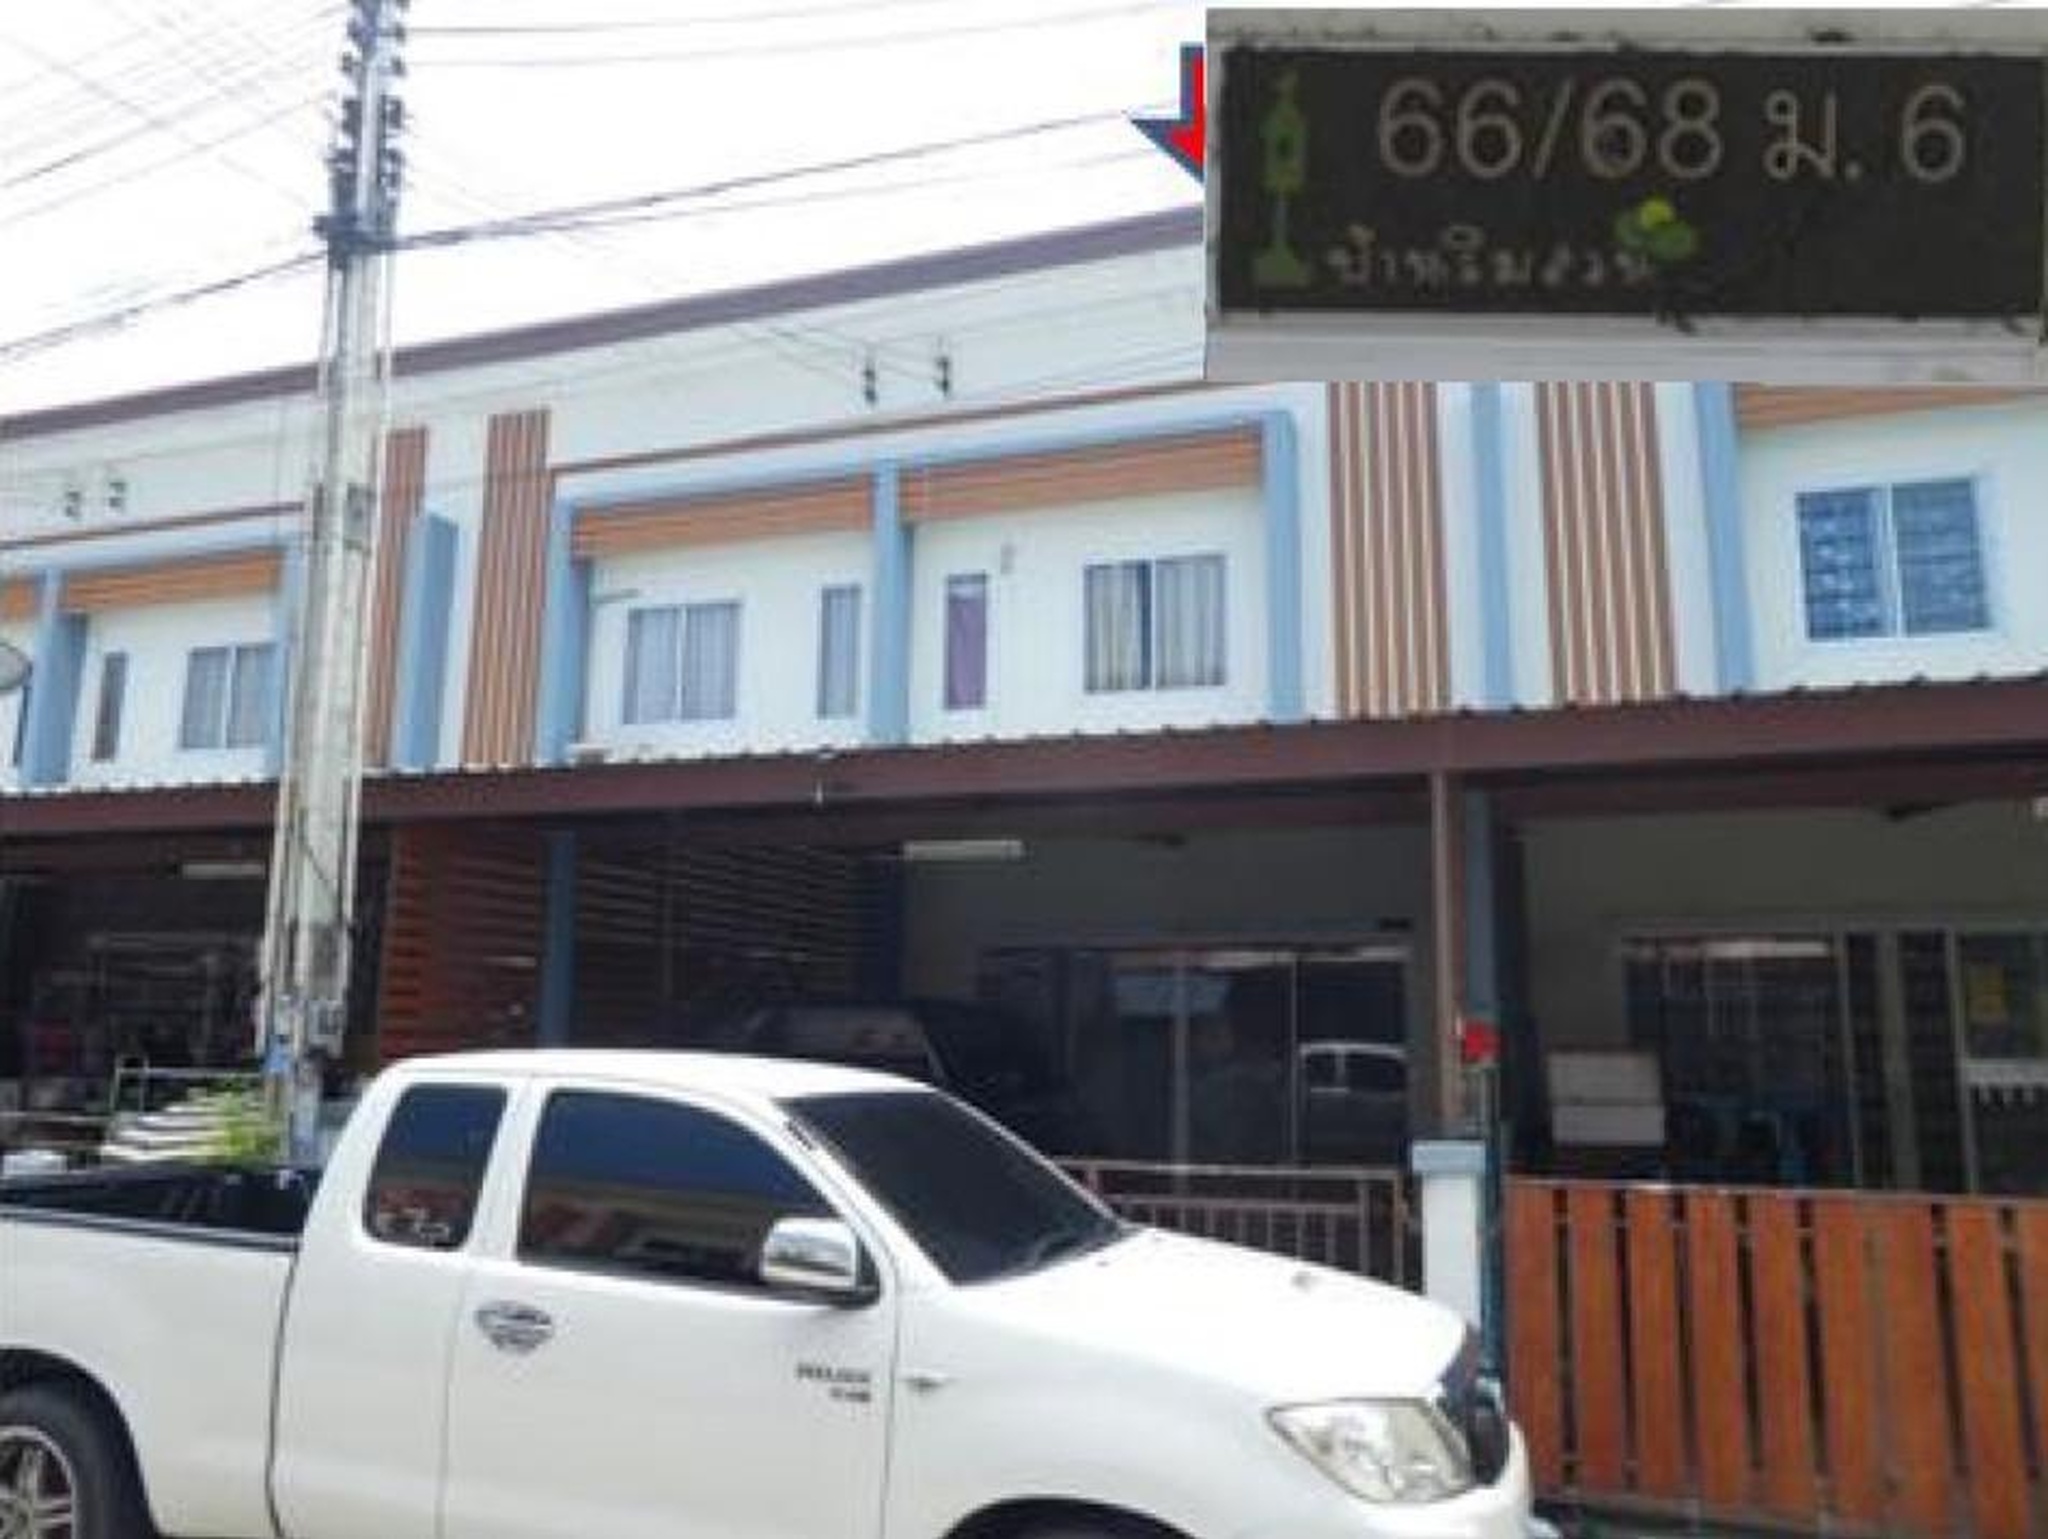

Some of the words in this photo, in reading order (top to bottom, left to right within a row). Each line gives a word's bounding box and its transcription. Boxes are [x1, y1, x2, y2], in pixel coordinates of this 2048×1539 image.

[1379, 78, 1722, 180] 66/68
[1763, 89, 1862, 181] ม.
[1903, 84, 1965, 182] 6
